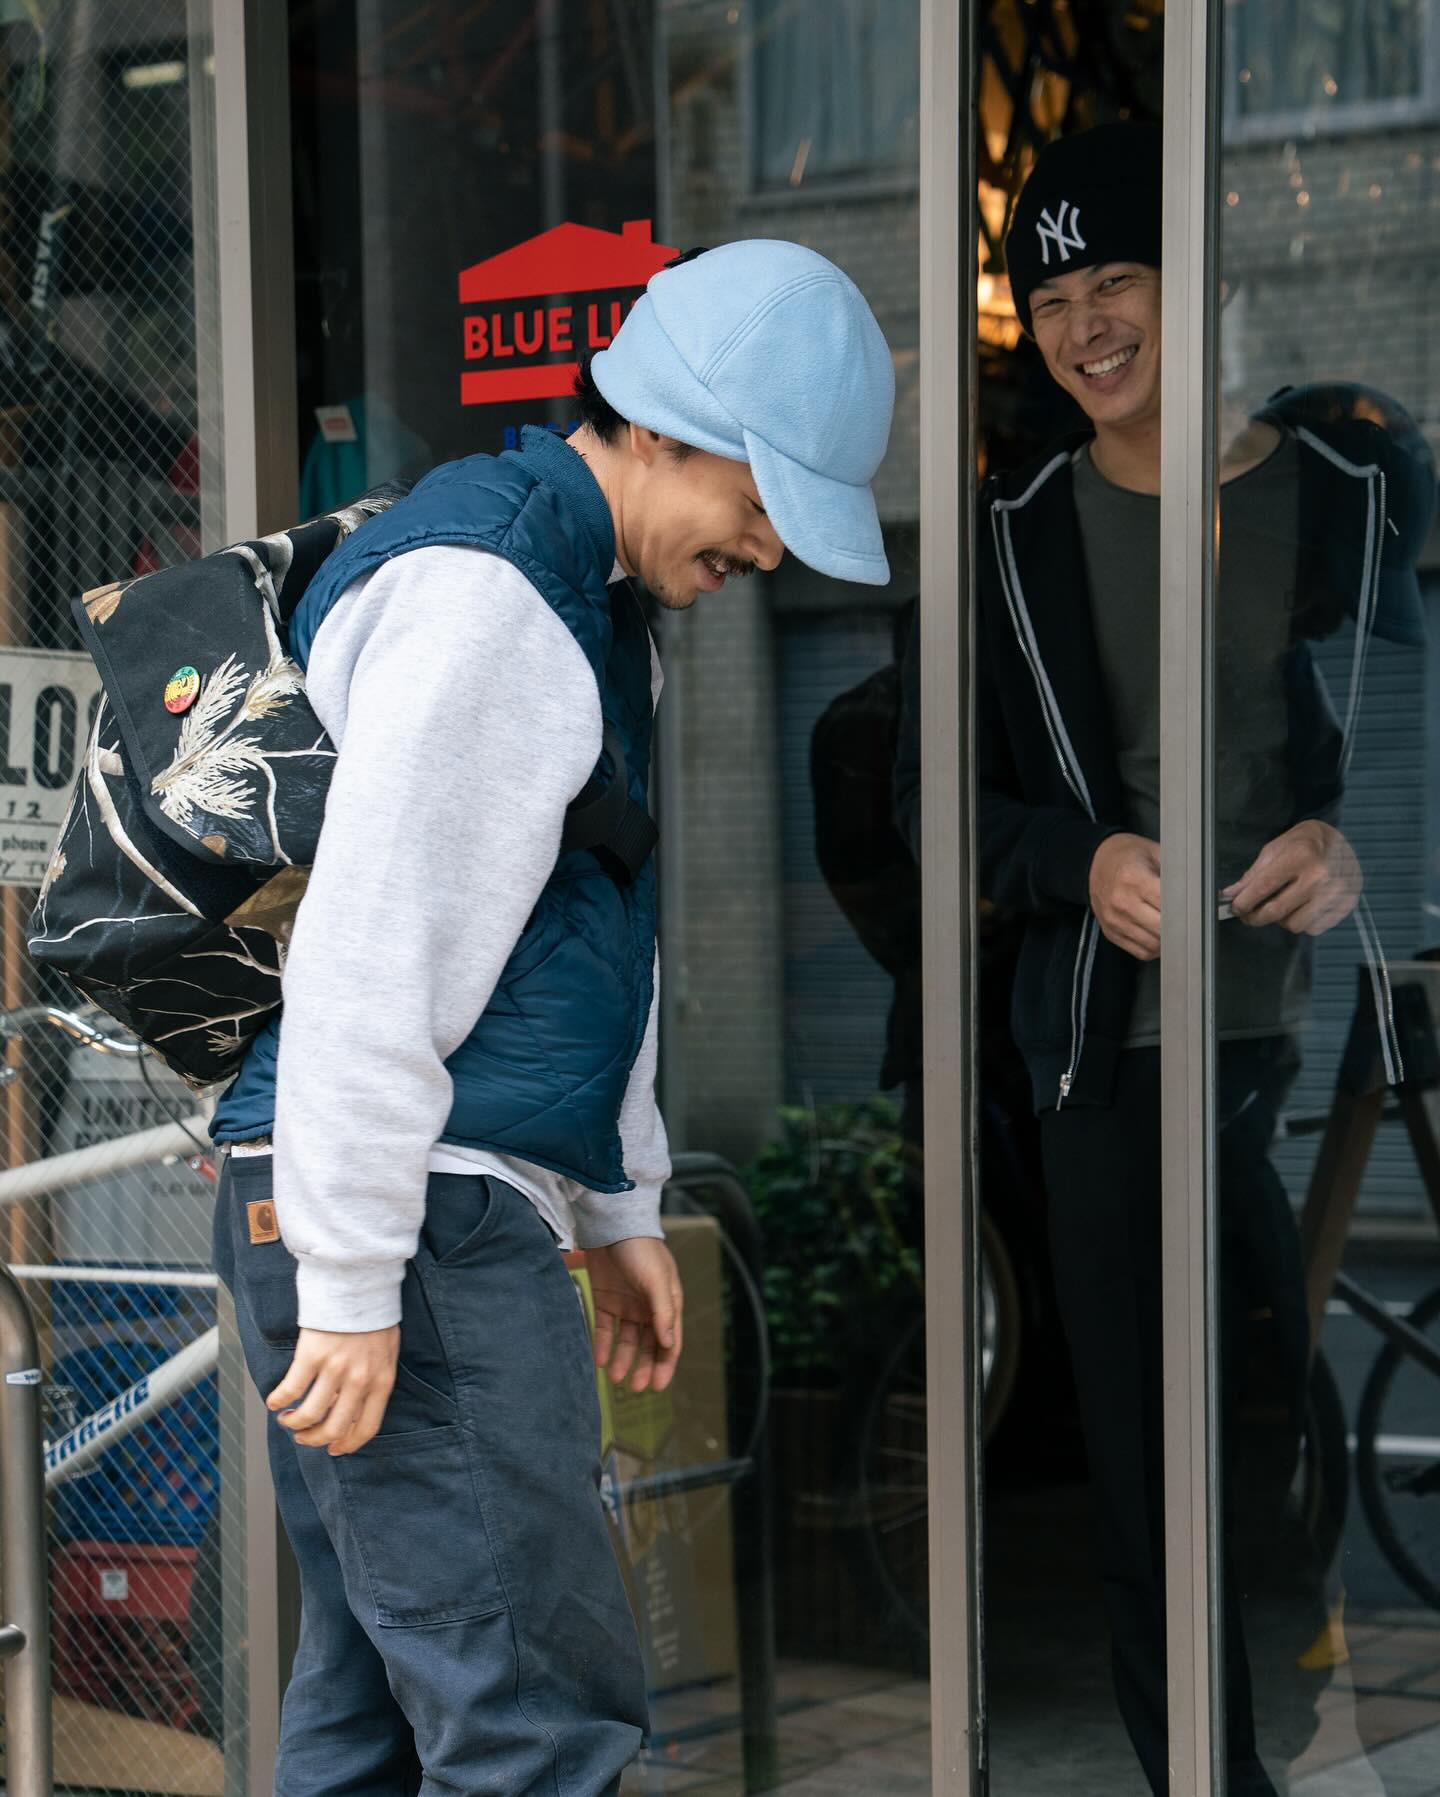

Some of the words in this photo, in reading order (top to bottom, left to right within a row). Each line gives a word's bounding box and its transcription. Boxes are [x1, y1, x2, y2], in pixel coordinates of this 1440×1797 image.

[1036, 200, 1087, 264] NY
[464, 306, 573, 360] BLUE
[0, 684, 98, 790] LO
